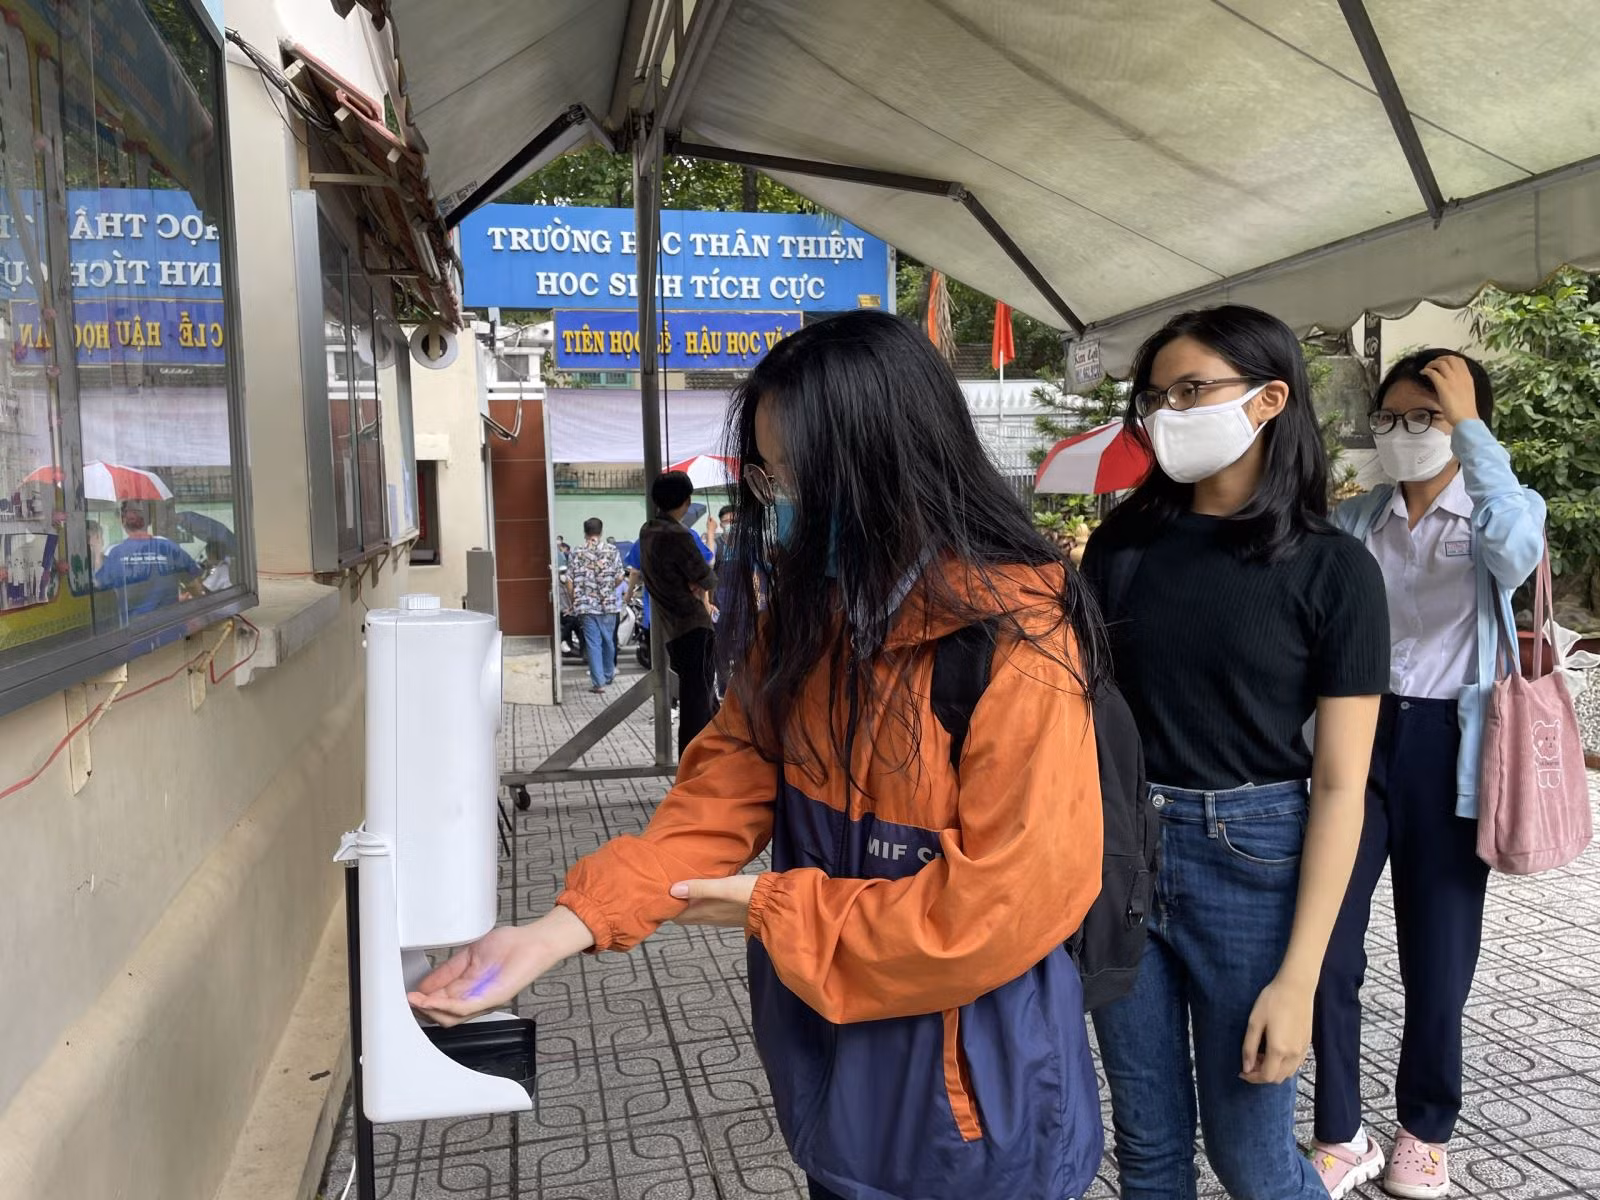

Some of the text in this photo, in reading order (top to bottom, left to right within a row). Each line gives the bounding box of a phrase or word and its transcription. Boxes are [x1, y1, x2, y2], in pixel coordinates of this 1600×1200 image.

[487, 217, 865, 265] TRƯỜNG HC THÂN THIỆN
[608, 272, 684, 299] SIH
[690, 267, 760, 299] TÍCH
[769, 273, 825, 305] CỰC
[685, 325, 722, 360] HẬU
[726, 331, 761, 360] HỌC
